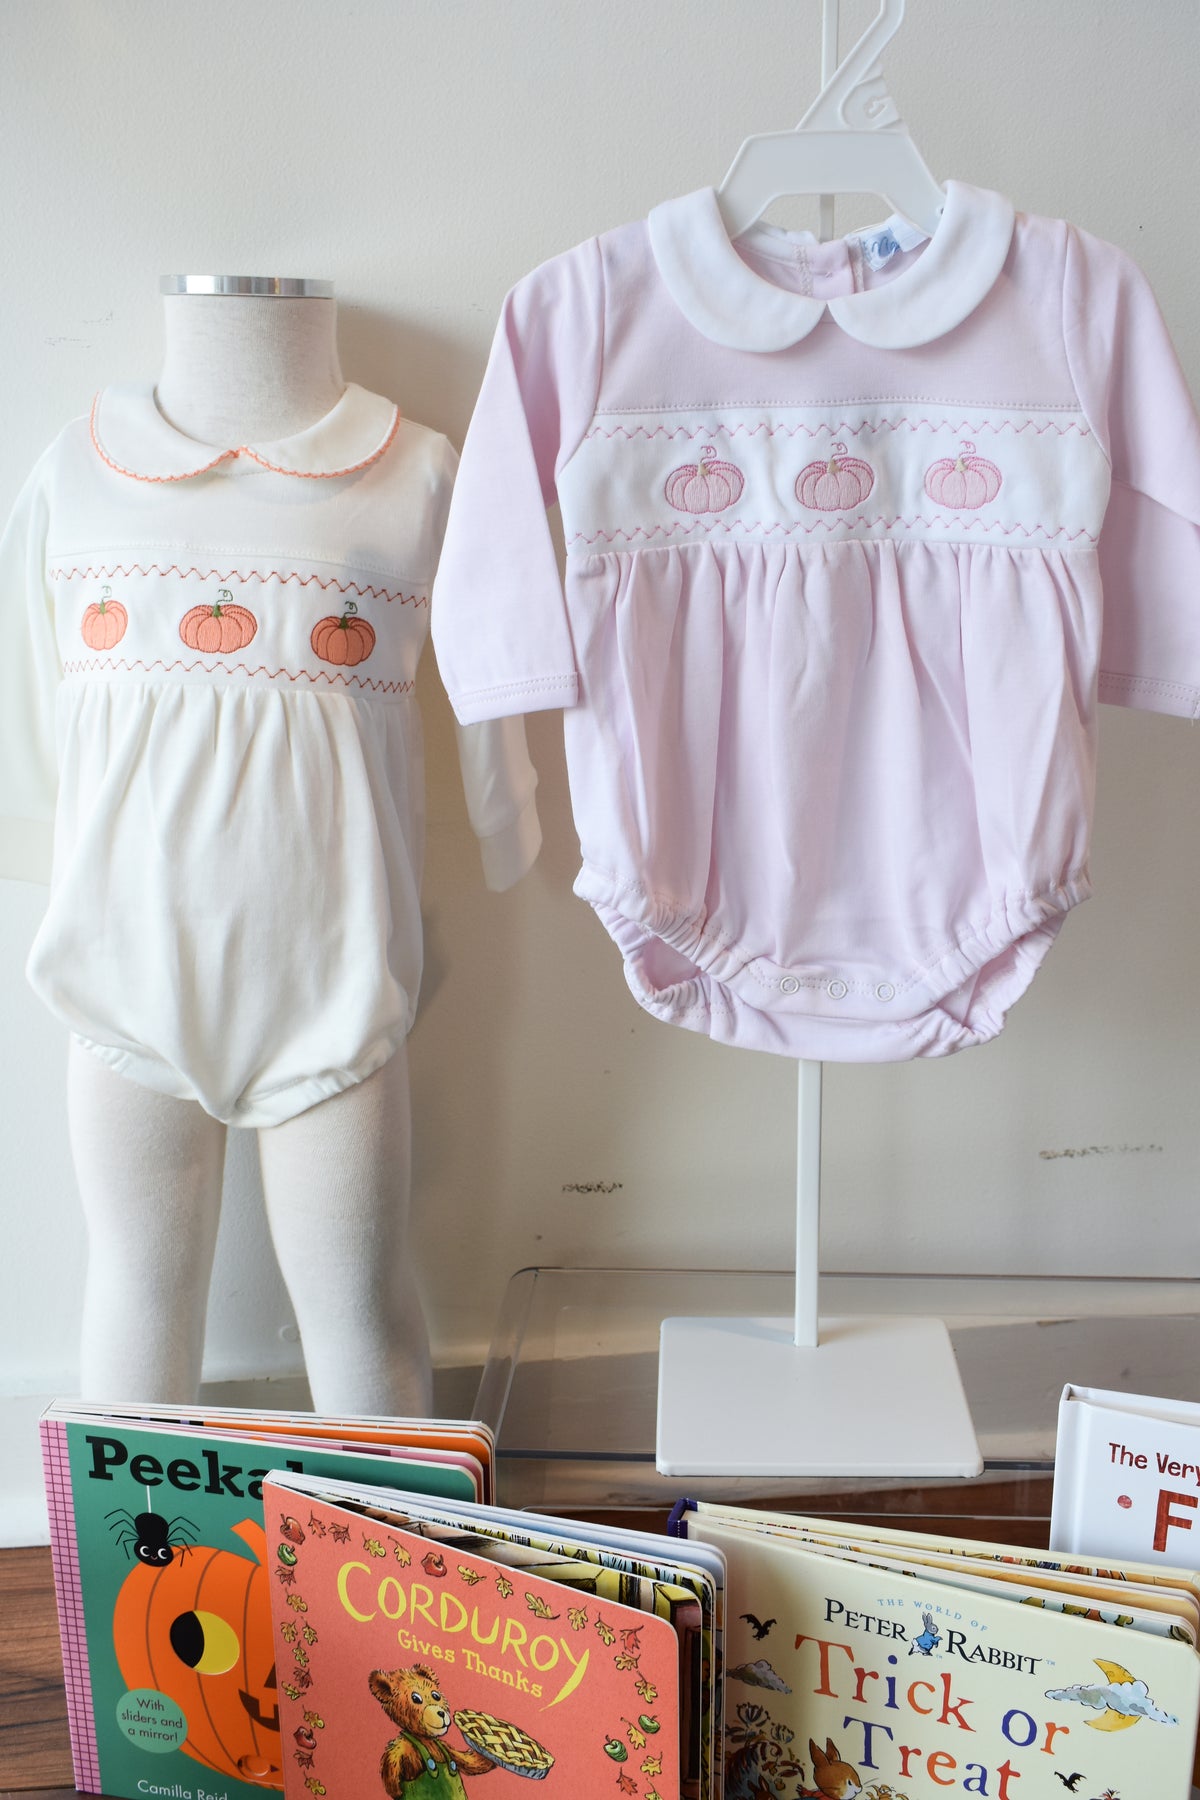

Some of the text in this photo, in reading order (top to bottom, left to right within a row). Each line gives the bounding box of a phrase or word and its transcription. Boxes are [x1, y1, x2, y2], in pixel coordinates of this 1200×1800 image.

[85, 1435, 304, 1501] Peeka
[1109, 1442, 1148, 1470] The
[337, 1561, 590, 1711] CORDUROY
[824, 1598, 909, 1642] PETER
[946, 1629, 1043, 1675] RABBIT
[877, 1599, 989, 1633] THE WORLD OF
[398, 1629, 543, 1698] Gives Thanks
[121, 1709, 183, 1729] sliders and
[137, 1697, 165, 1711] With
[795, 1633, 1070, 1755] Trick or
[127, 1728, 178, 1743] a mirror!
[843, 1716, 1021, 1800] Treat
[137, 1780, 192, 1800] Camilla
